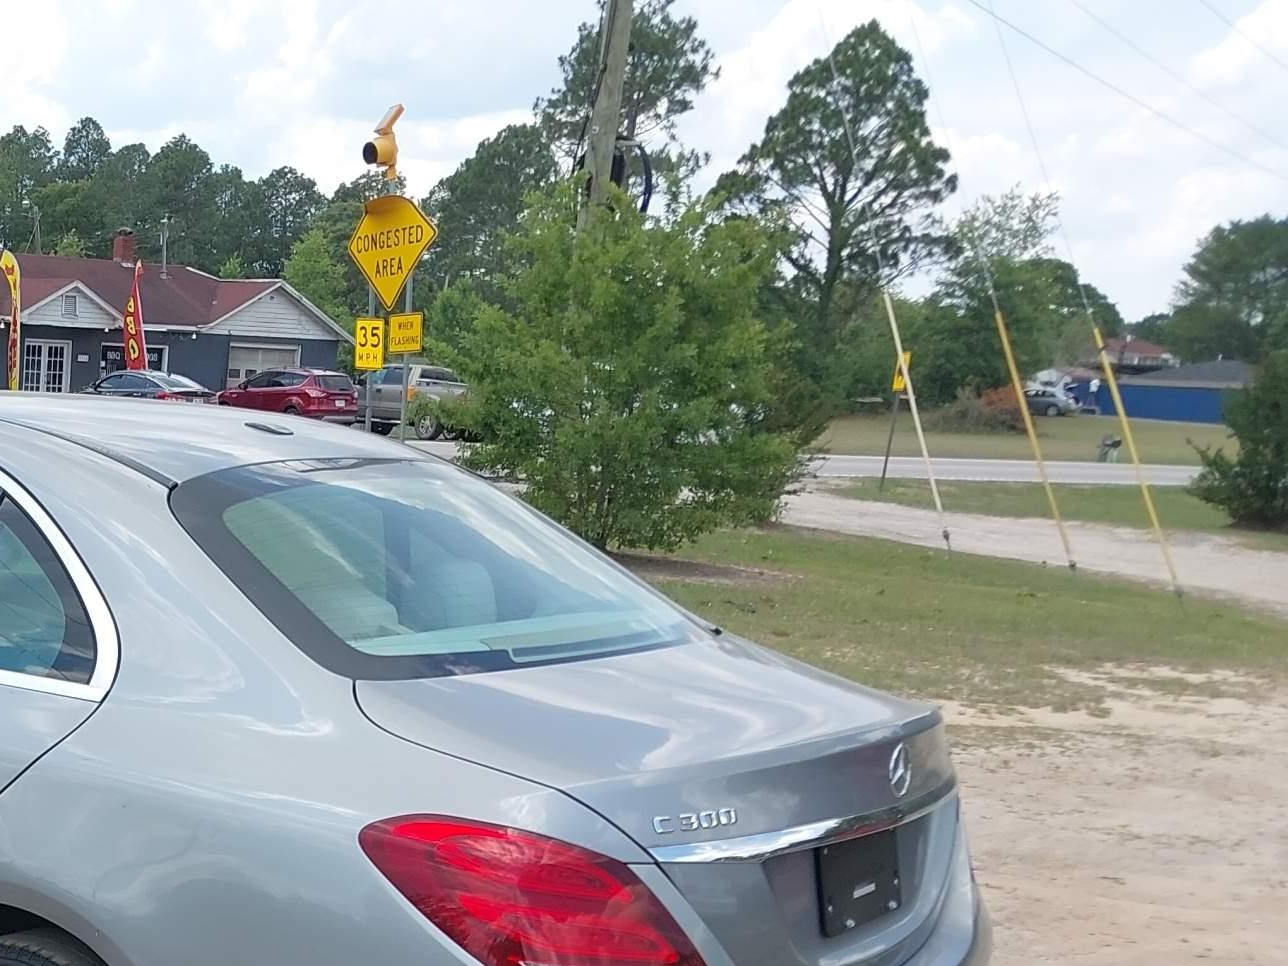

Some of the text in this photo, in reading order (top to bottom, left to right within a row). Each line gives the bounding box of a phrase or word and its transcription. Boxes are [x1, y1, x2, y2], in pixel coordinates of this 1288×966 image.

[356, 225, 424, 254] CONGESTED
[375, 256, 403, 278] AREA
[398, 320, 414, 331] WHEN
[359, 326, 380, 348] 35
[392, 335, 419, 346] FLASHING
[358, 352, 378, 362] MPH
[653, 808, 738, 834] C 300
